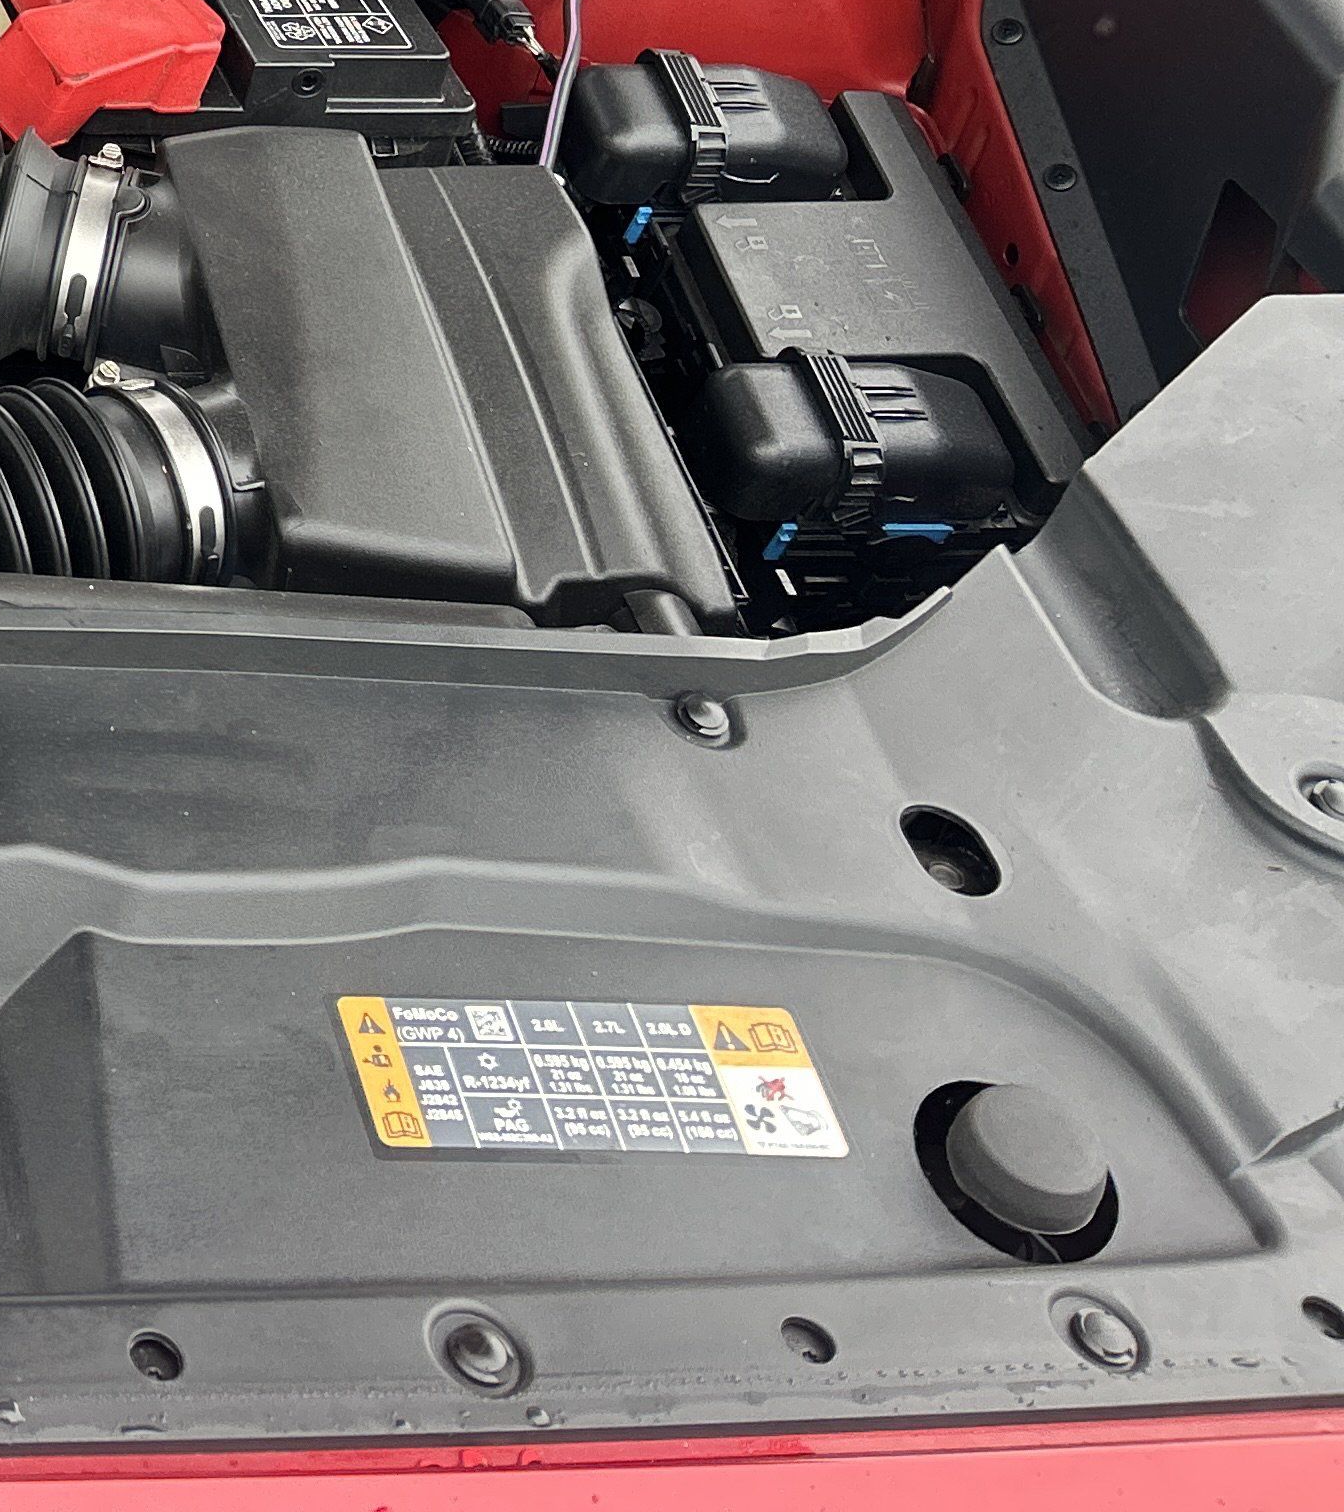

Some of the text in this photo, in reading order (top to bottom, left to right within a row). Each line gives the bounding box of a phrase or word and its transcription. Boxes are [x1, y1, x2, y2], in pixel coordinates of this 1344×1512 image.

[391, 1006, 459, 1022] FoMoCo
[396, 1026, 465, 1044] (GWP 4)
[413, 1064, 445, 1077] SAE
[570, 1054, 590, 1072] kg
[632, 1056, 653, 1073] kg
[692, 1058, 713, 1076] kg
[462, 1074, 530, 1093] R-1234yf
[493, 1117, 530, 1133] PAG
